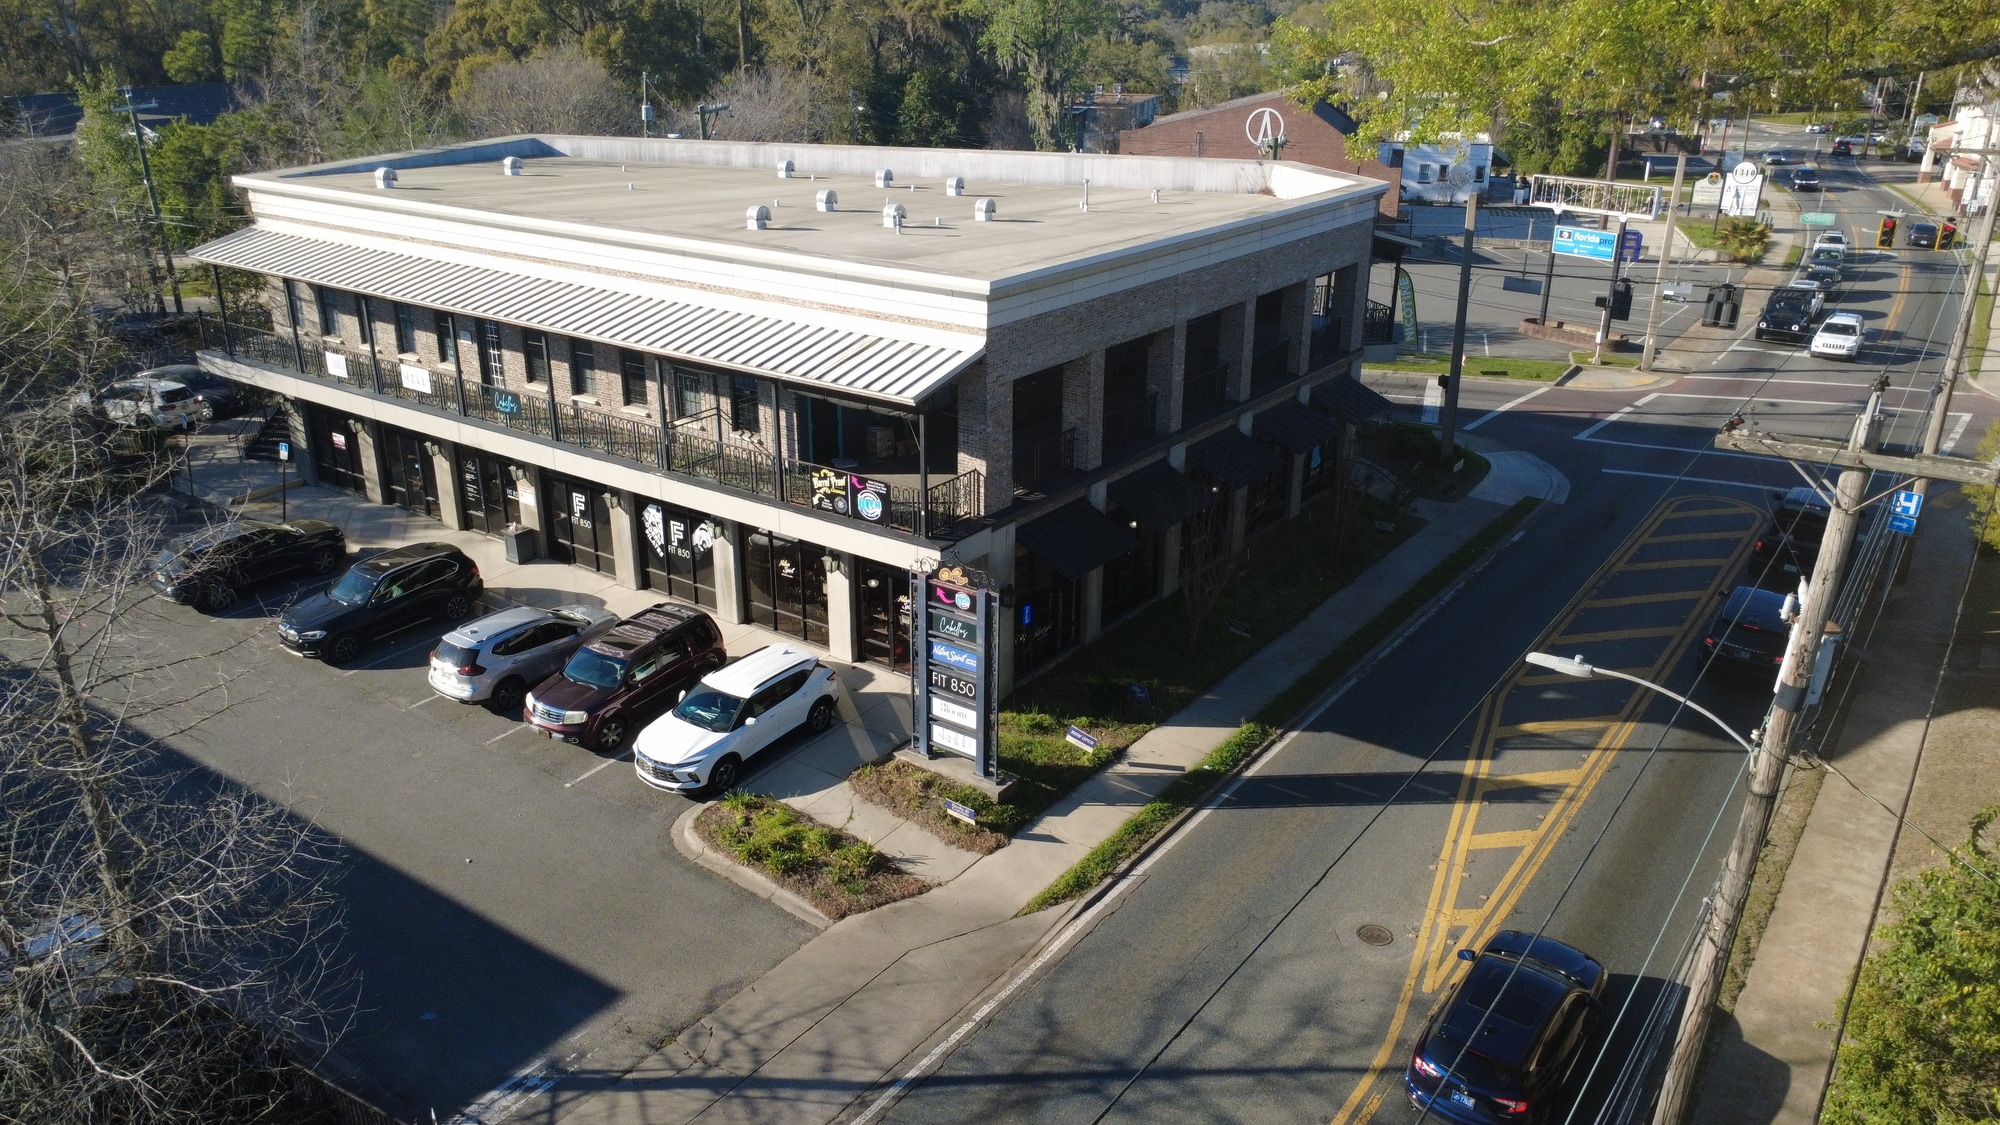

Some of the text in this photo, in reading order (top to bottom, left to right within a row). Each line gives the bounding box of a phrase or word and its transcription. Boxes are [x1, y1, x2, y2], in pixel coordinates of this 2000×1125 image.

[1895, 492, 1918, 514] H
[571, 516, 592, 529] FIT 850
[668, 545, 691, 559] FIT 850
[932, 671, 975, 697] FIT 850
